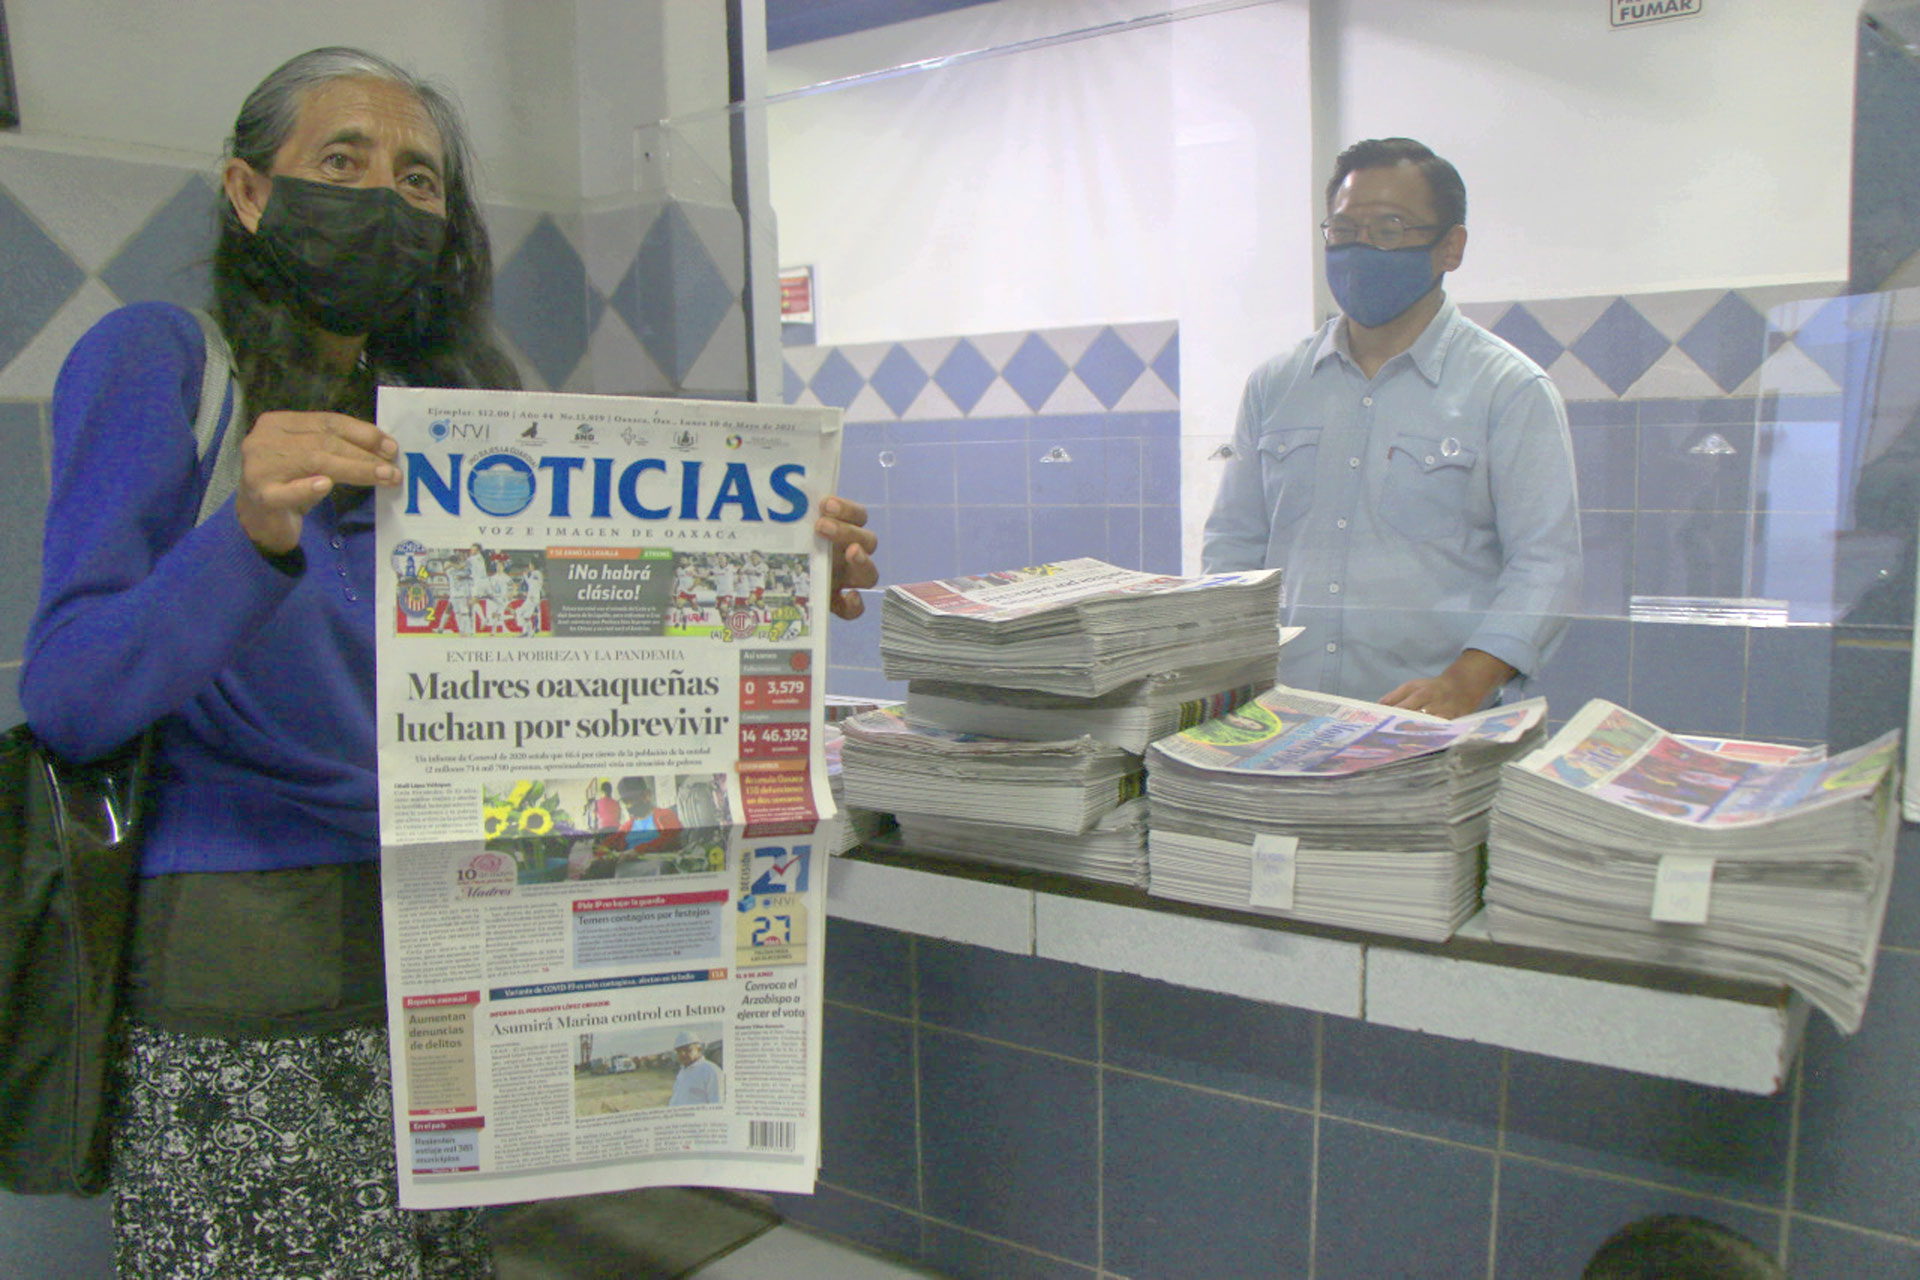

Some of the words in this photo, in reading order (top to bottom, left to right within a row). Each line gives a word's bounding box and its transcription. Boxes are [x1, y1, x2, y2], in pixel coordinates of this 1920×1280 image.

[1620, 0, 1692, 21] FUMAR
[478, 408, 509, 418] $12.00
[404, 452, 809, 524] NOTICIAS
[478, 526, 514, 537] VOZ
[526, 527, 534, 537] E
[546, 527, 620, 538] IMAGEN
[632, 528, 654, 538] DE
[664, 529, 737, 539] OAXACA
[418, 565, 430, 579] 4
[601, 564, 651, 580] habrá
[577, 584, 641, 601] clásico!
[425, 607, 436, 621] 2
[723, 629, 733, 642] 2
[769, 628, 779, 642] 2
[446, 650, 494, 662] ENTRE
[497, 650, 514, 662] LA
[517, 649, 581, 662] POBREZA
[583, 649, 592, 660] Y
[594, 649, 612, 661] LA
[615, 649, 685, 661] PANDEMIA
[407, 669, 530, 701] Madres
[536, 669, 720, 705] oaxaqueñas
[744, 681, 755, 695] 0
[767, 681, 805, 696] 3,579
[397, 712, 506, 742] luchan
[514, 718, 571, 748] por
[576, 707, 730, 738] sobrevivir
[742, 729, 756, 743] 14
[762, 729, 808, 743] 46,392
[457, 868, 477, 881] 10
[751, 845, 812, 895] 21
[579, 915, 609, 926] Temen
[611, 910, 656, 924] contagios
[657, 910, 673, 921] por
[674, 907, 710, 919] festejos
[752, 915, 791, 947] 27
[745, 979, 787, 992] Convoca
[788, 978, 798, 990] el
[741, 992, 792, 1005] Arzobispo
[793, 995, 801, 1003] a
[409, 1013, 466, 1024] Aumentan
[492, 1016, 553, 1036] Asumirá
[558, 1013, 609, 1029] Marina
[612, 1007, 661, 1025] control
[665, 1008, 682, 1019] en
[686, 1003, 726, 1017] Istmo
[737, 1009, 769, 1021] ejercer
[772, 1007, 781, 1018] el
[782, 1008, 805, 1018] voto
[409, 1026, 464, 1038] denuncias
[410, 1040, 424, 1051] de
[425, 1039, 463, 1050] delitos
